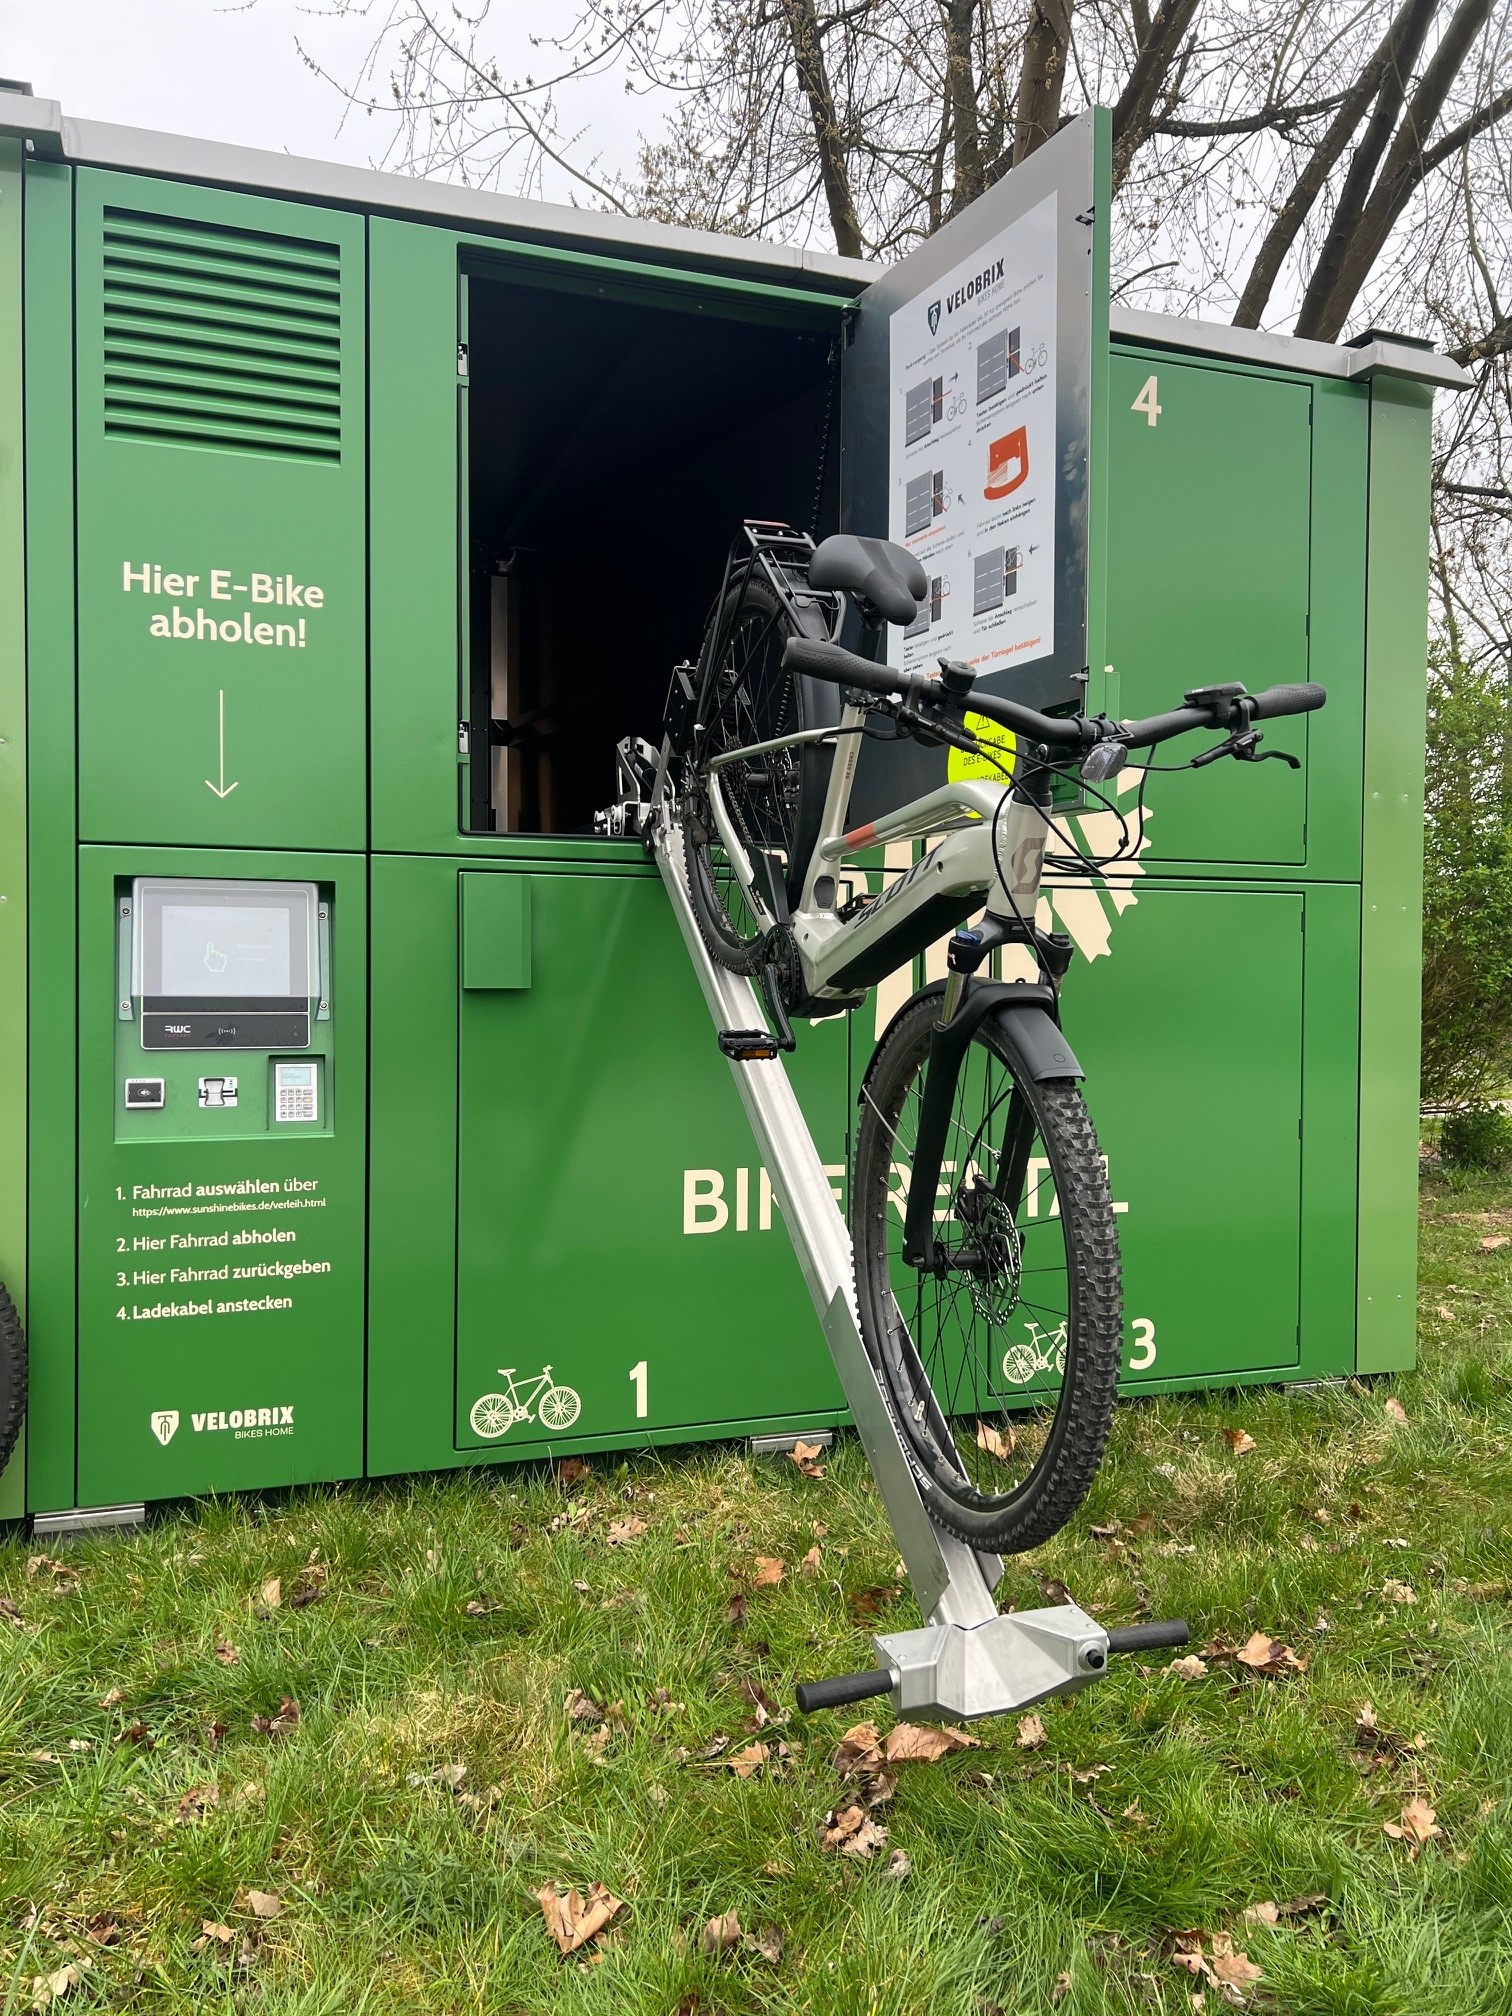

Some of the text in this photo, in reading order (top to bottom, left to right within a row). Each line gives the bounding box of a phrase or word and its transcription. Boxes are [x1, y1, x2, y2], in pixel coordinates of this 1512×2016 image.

[947, 258, 1004, 314] VELOBRIX
[977, 280, 1004, 305] BIKES HOME
[1130, 375, 1162, 426] 4
[123, 561, 324, 608] Hier E-Bike
[150, 605, 306, 648] abholen!
[981, 653, 990, 661] der
[964, 755, 976, 766] DES
[164, 1025, 191, 1034] RWC
[115, 1177, 318, 1200] 1. Fahrrad auswählen über
[132, 1198, 326, 1218] https://www.sunshinebikes.de/verleih.html
[116, 1228, 296, 1252] 2. Hier Fahrrad abholen
[116, 1260, 331, 1287] 3. Hier Fahrrad zurückgeben
[116, 1295, 293, 1321] 4. Ladekabel anstecken
[1129, 1317, 1157, 1370] 3
[629, 1361, 648, 1418] 1
[191, 1406, 294, 1431] VELOBRIX
[235, 1427, 294, 1439] BIKES HOME
